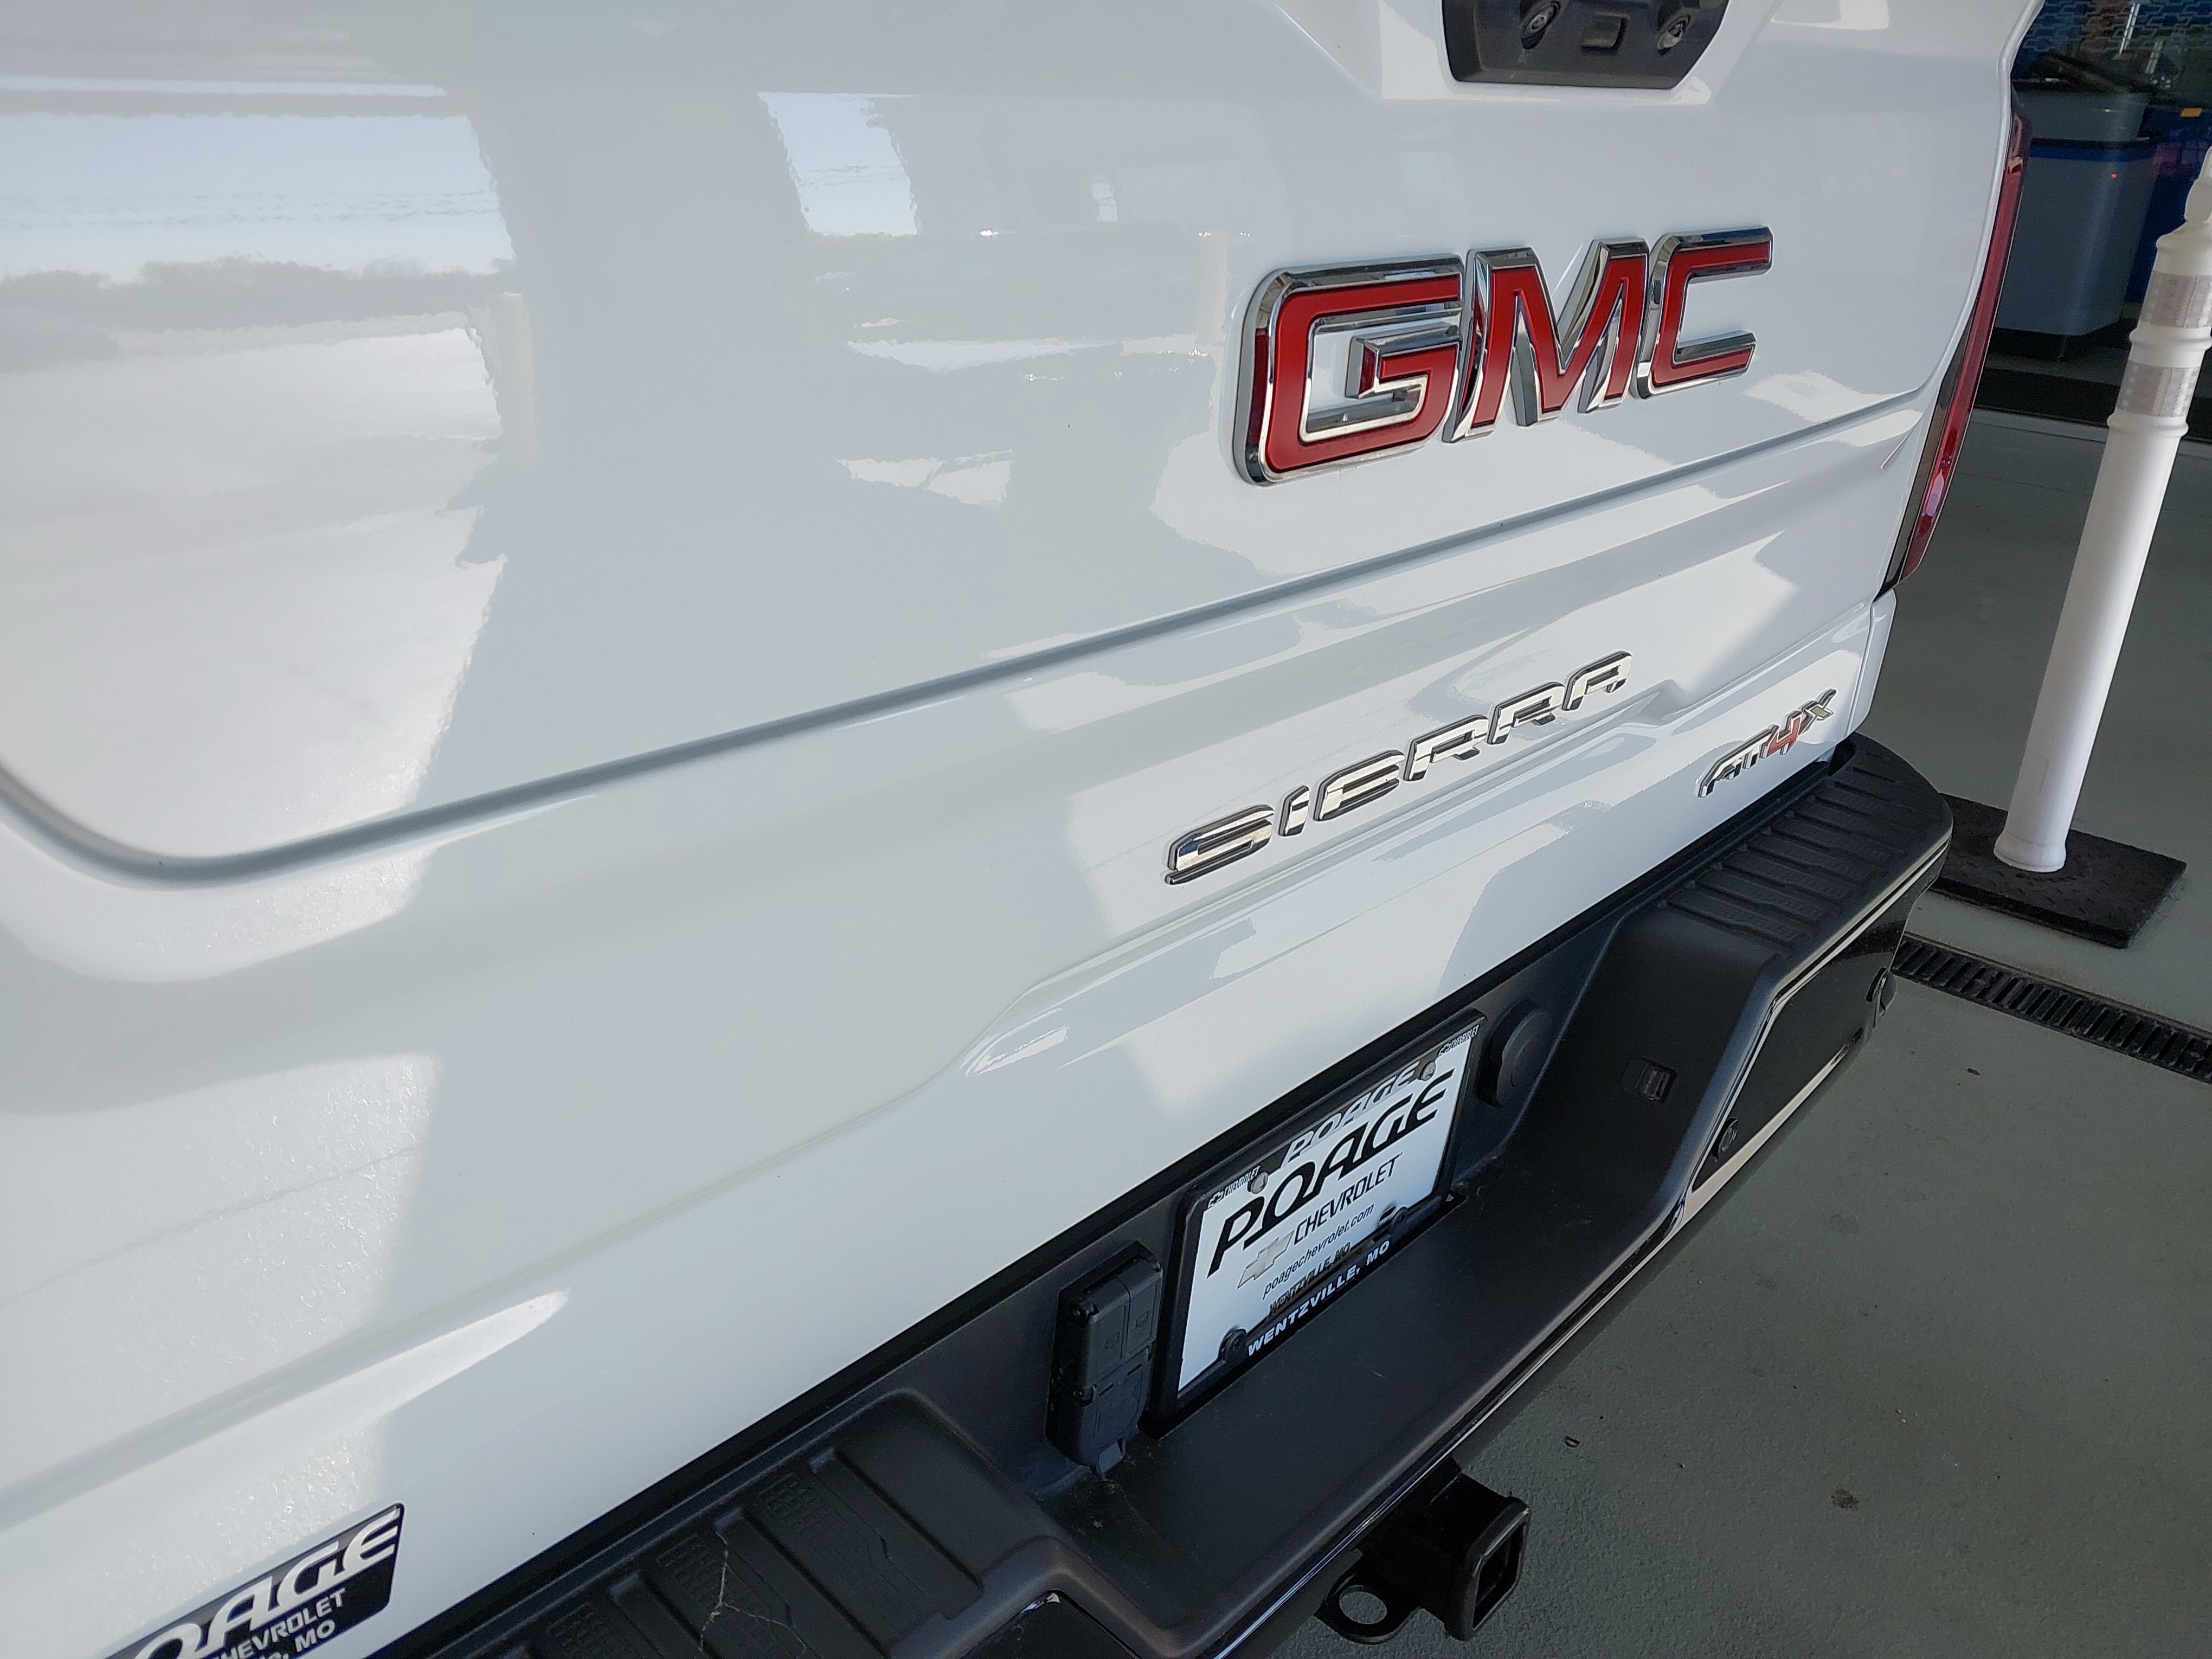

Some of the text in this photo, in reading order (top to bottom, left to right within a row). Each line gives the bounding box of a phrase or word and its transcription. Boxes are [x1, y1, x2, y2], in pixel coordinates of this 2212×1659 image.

[1232, 226, 1773, 487] GMC
[1164, 651, 1632, 885] SIERRA
[1697, 689, 1837, 798] AT4X
[1206, 1068, 1456, 1279] POAGE
[1225, 1165, 1261, 1197] CHEVROLET
[1294, 1152, 1401, 1246] CHEVROLET
[1248, 1240, 1390, 1356] WENTZVILLE, MO
[1262, 1203, 1374, 1301] poagechevrolet.com
[217, 1587, 346, 1659] HEVROLET
[295, 1619, 336, 1652] MO
